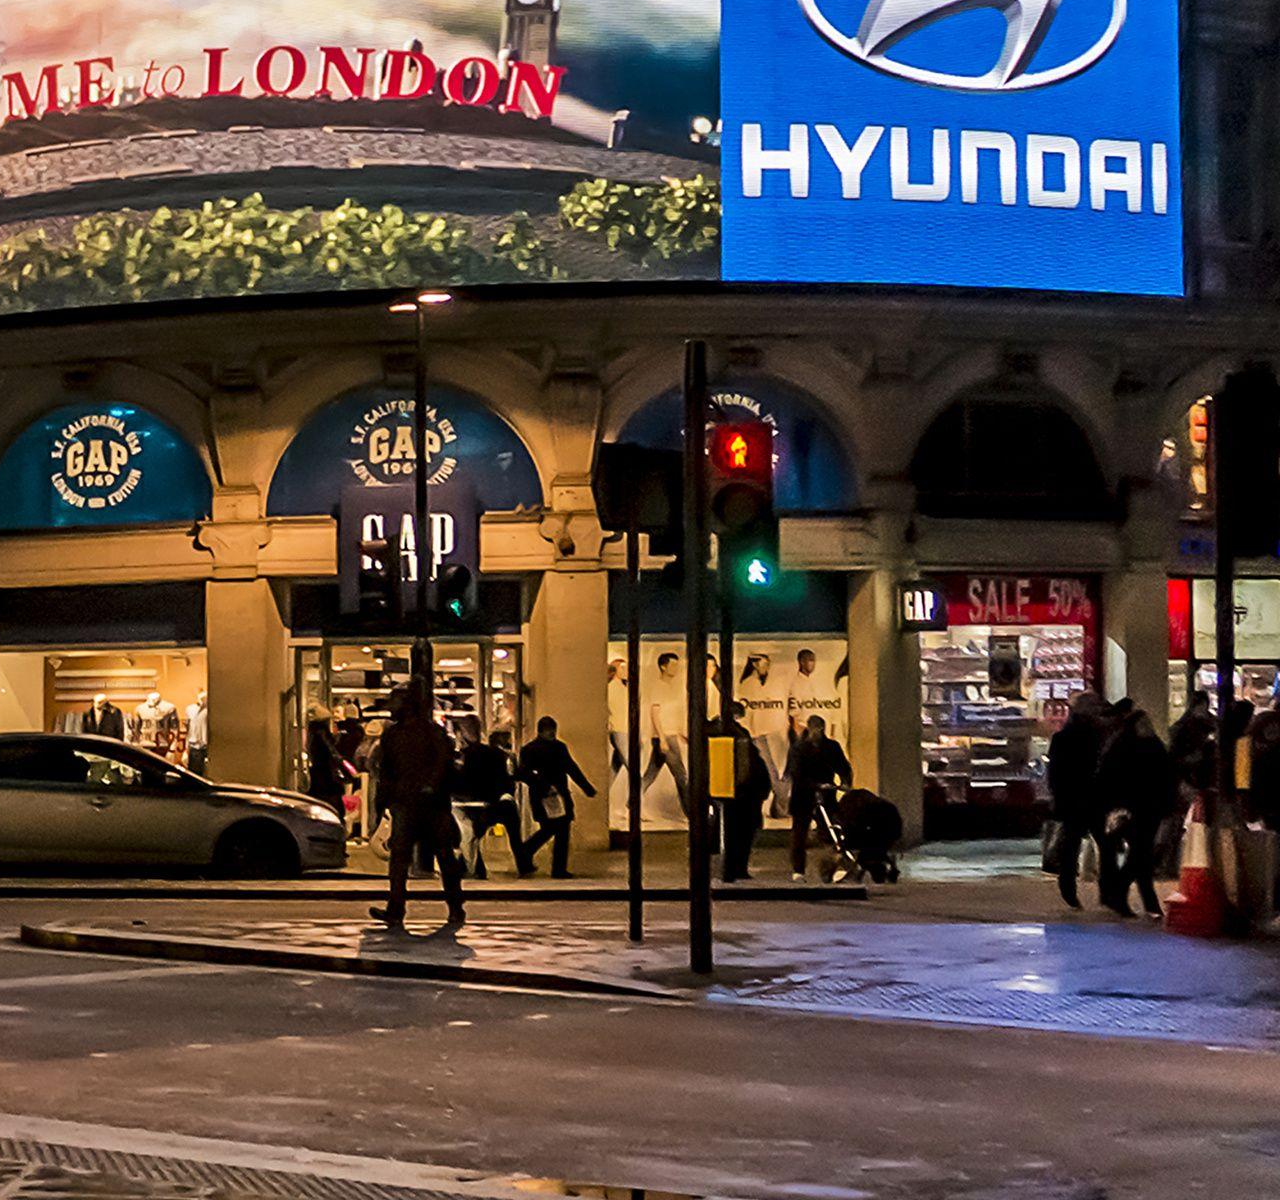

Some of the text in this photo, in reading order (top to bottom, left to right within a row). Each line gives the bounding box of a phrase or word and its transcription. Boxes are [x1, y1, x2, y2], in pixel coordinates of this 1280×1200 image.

[141, 59, 186, 97] to
[202, 45, 568, 119] LONDON
[742, 123, 1168, 214] HYUNDAI
[125, 431, 142, 456] USA
[369, 426, 441, 465] GAP
[437, 418, 458, 443] USA
[66, 439, 129, 478] GAP
[382, 462, 417, 476] 196
[51, 468, 142, 508] LONDON EDITION
[78, 473, 115, 488] 1969
[904, 590, 934, 621] GAP
[968, 579, 1092, 623] SALE 50%
[740, 696, 841, 710] Denim Evolved
